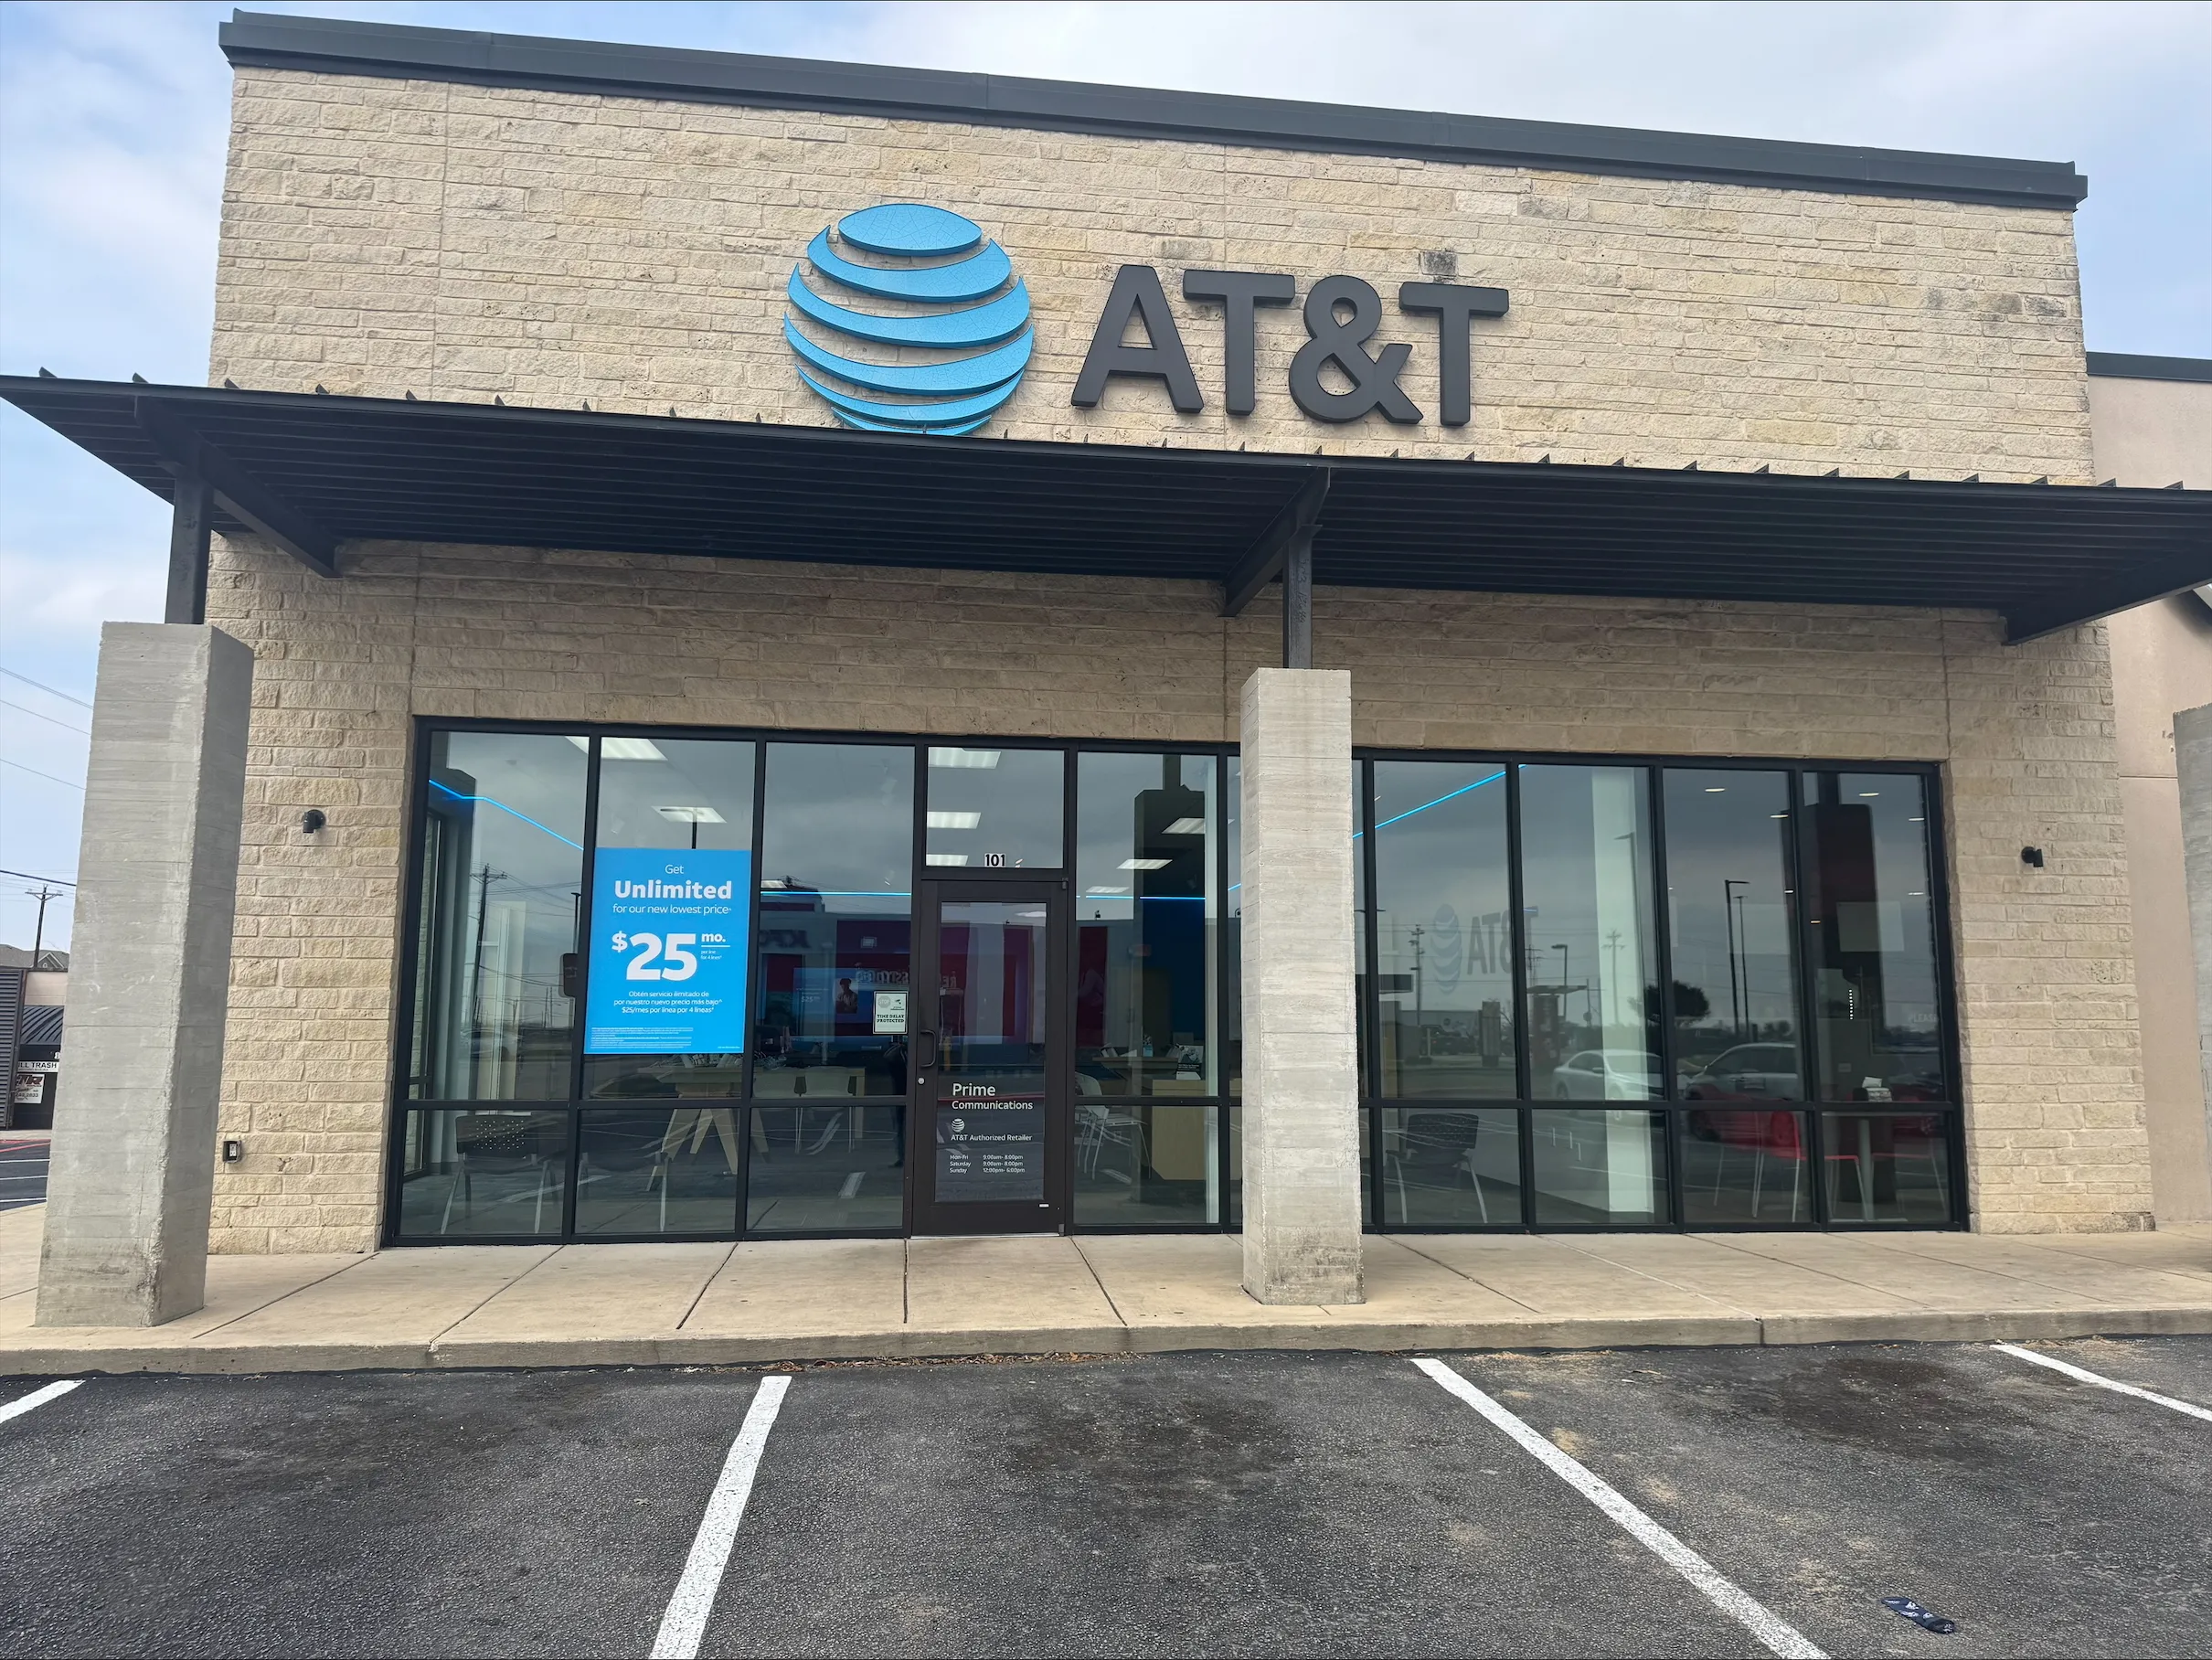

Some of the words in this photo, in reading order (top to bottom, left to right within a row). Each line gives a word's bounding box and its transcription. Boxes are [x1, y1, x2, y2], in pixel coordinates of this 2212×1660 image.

[1071, 264, 1510, 426] AT&T
[985, 854, 1005, 867] 101
[665, 864, 685, 875] Get
[614, 879, 732, 899] Unlimited
[612, 903, 627, 913] for
[629, 905, 646, 913] our
[647, 905, 668, 913] new
[670, 904, 702, 914] lowest
[701, 932, 726, 942] mo.
[611, 931, 697, 981] $25
[952, 1083, 996, 1096] Prime
[952, 1100, 1034, 1110] Communications
